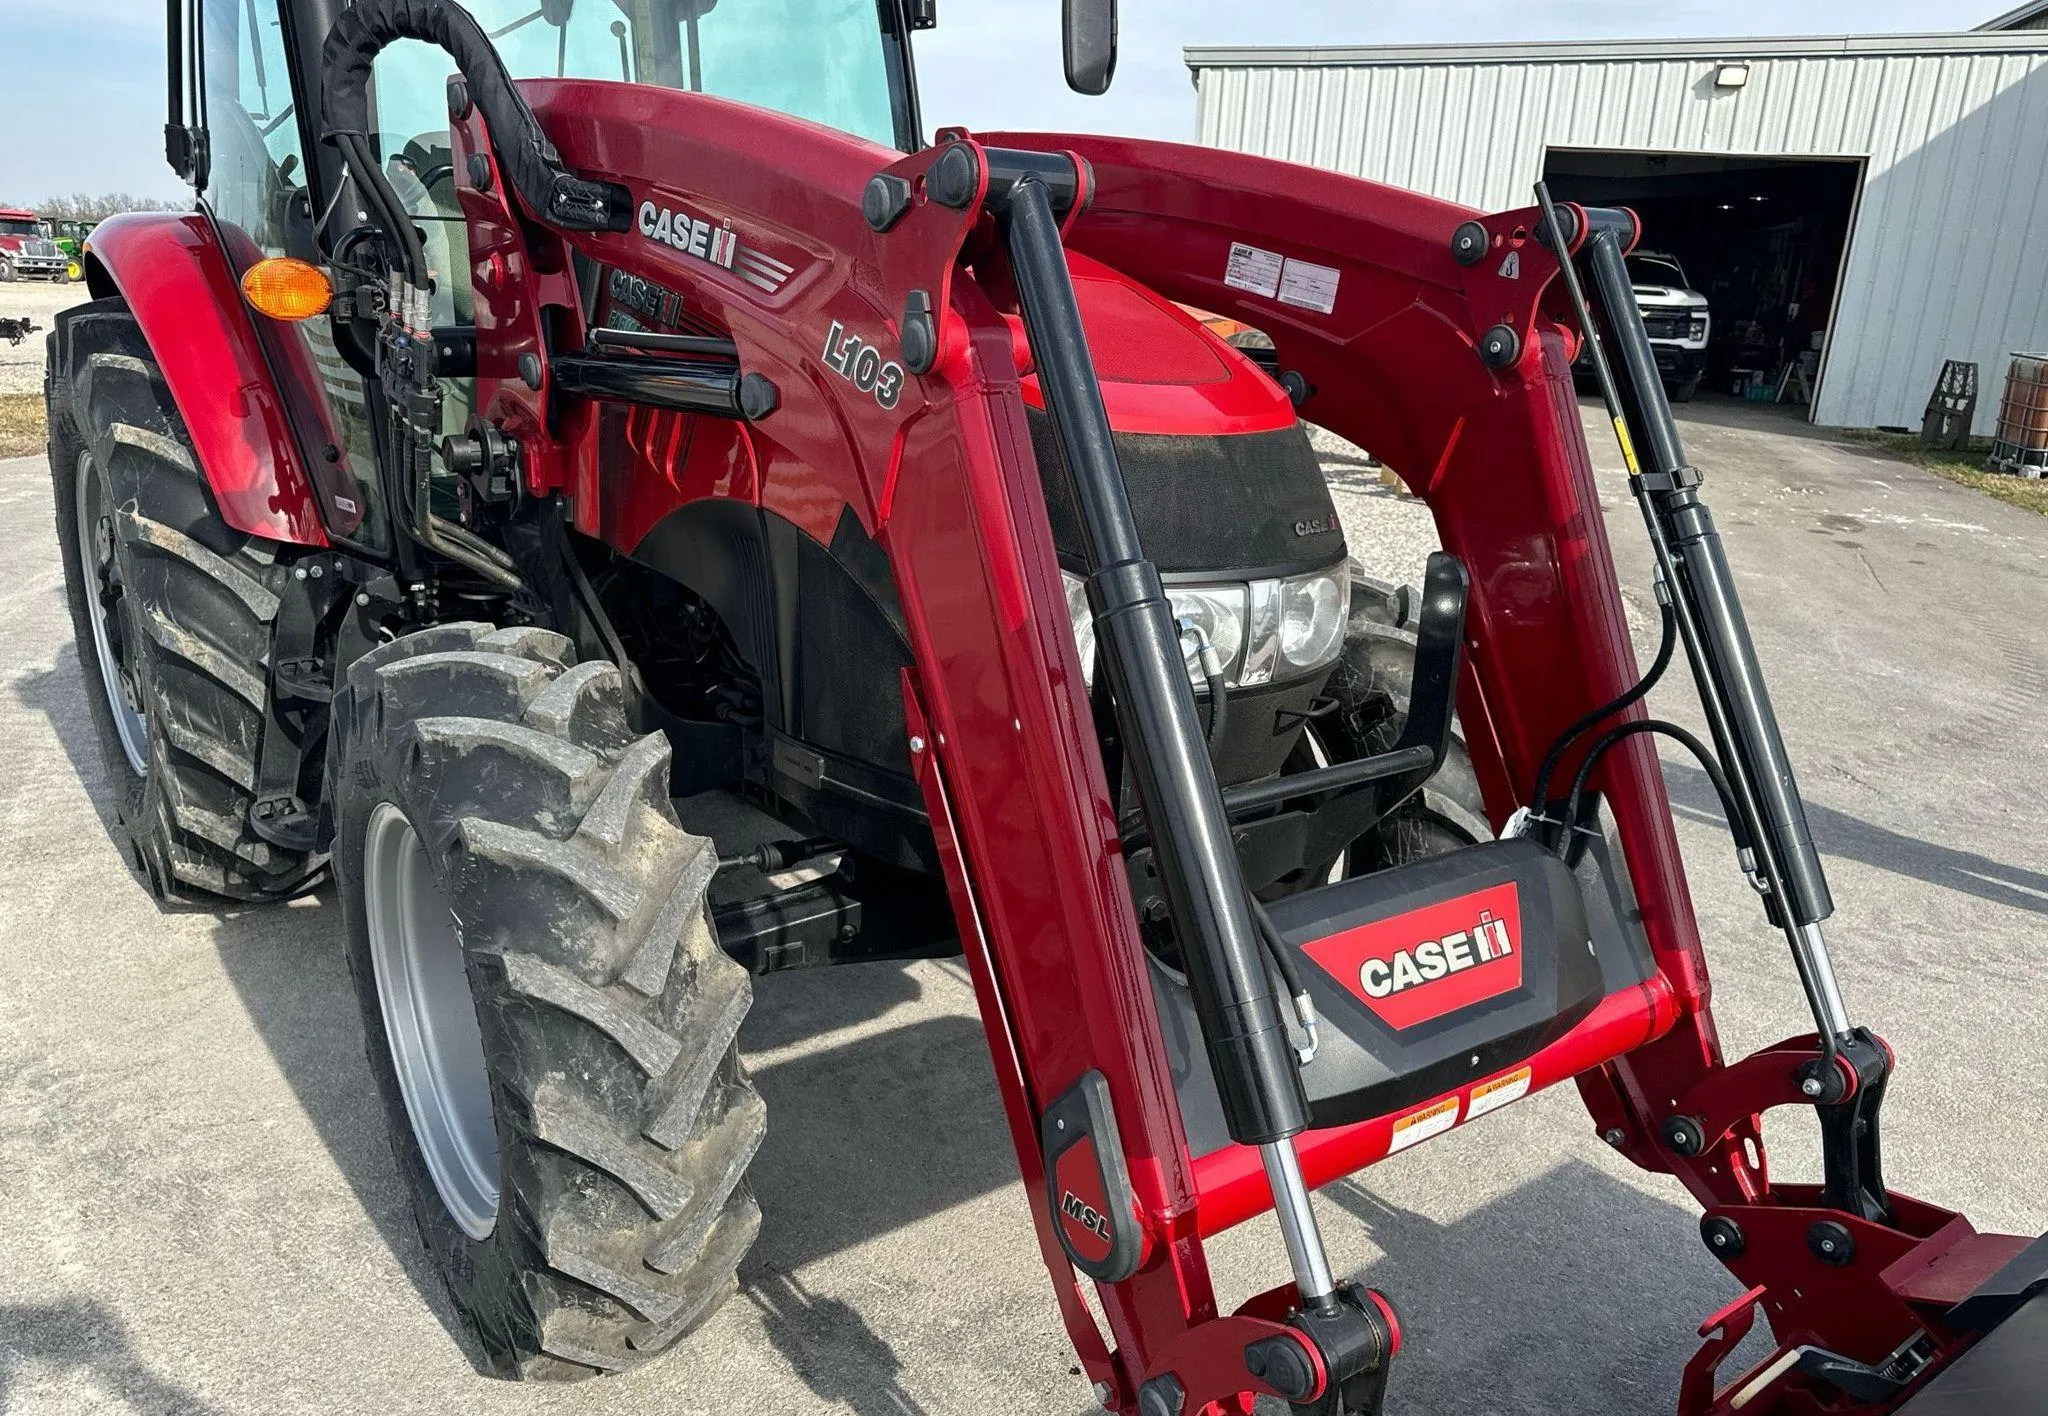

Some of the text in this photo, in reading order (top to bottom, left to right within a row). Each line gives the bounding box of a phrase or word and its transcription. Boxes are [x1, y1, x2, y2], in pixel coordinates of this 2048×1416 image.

[638, 201, 710, 257] CASE
[609, 268, 660, 316] CASE
[822, 320, 904, 410] L103
[1295, 519, 1329, 537] CASE
[1359, 930, 1475, 999] CASE
[1491, 1074, 1519, 1092] WARNING
[1416, 1104, 1446, 1120] WARNING
[1061, 1190, 1110, 1242] MSL
